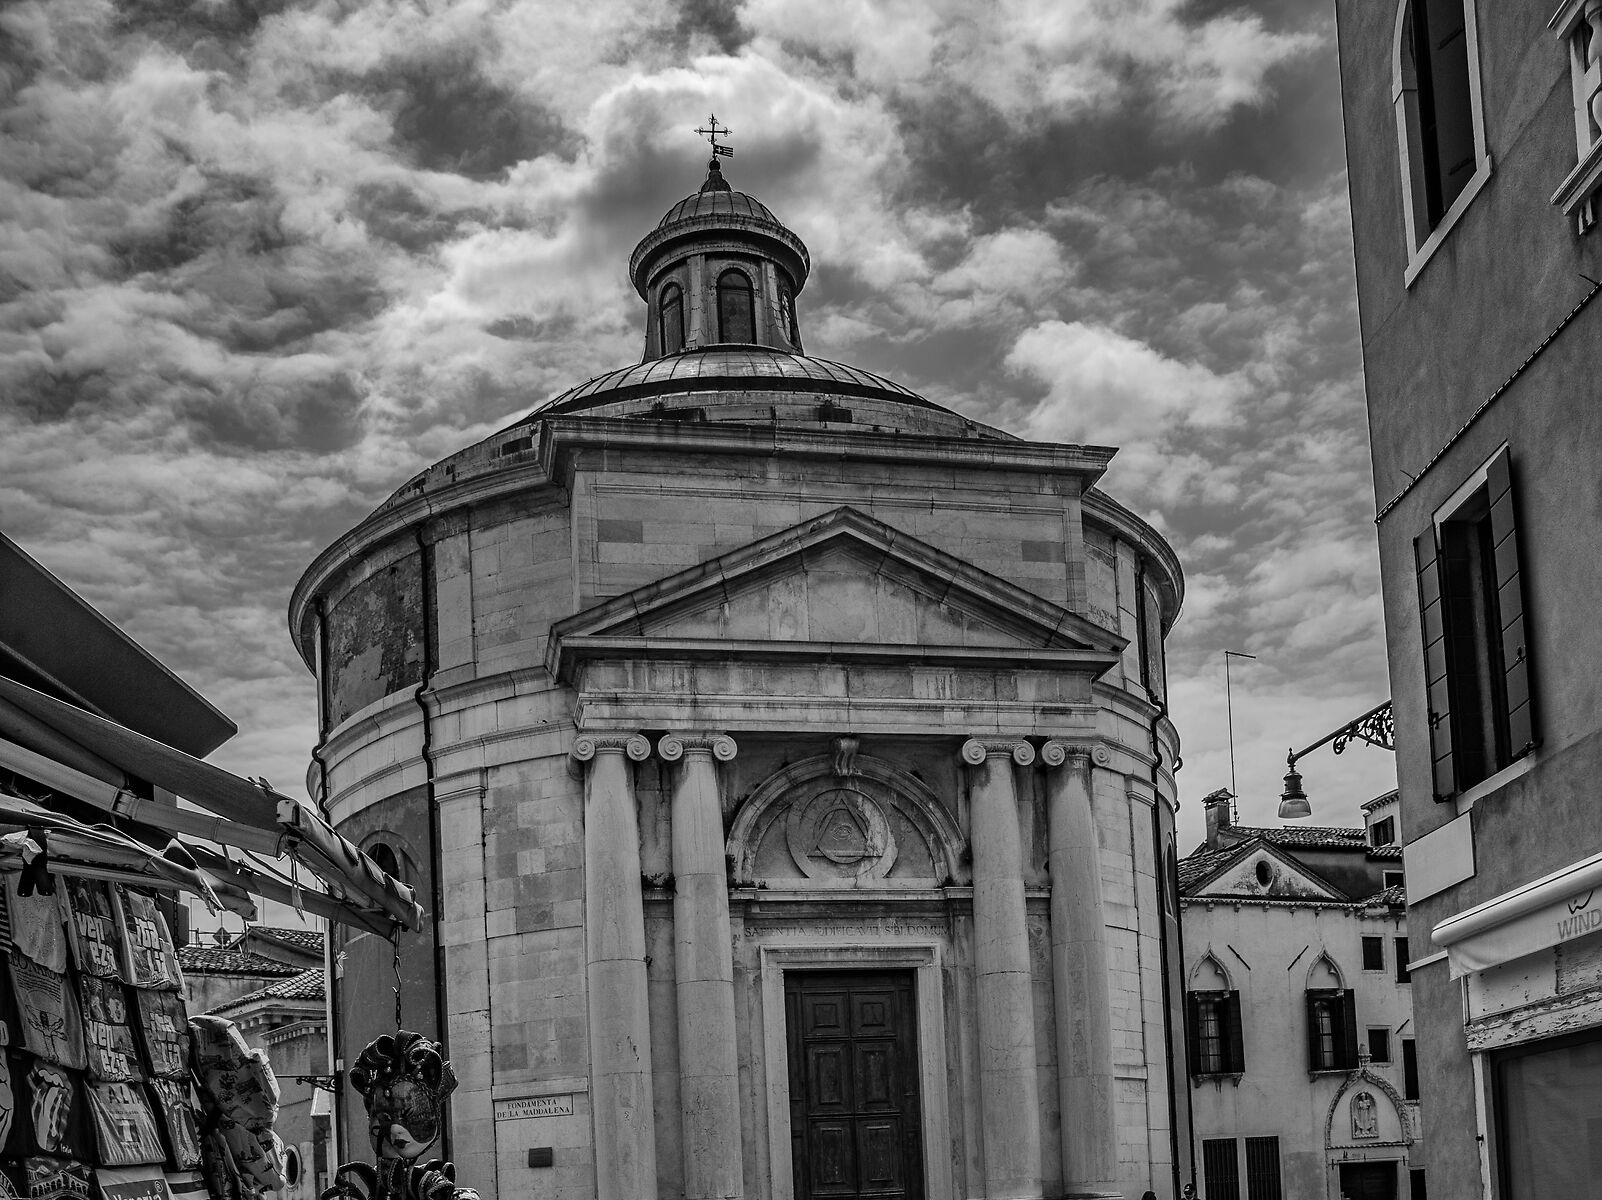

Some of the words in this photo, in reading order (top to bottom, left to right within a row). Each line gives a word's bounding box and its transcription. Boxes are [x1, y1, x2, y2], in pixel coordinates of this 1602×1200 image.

[507, 1099, 557, 1110] FONDAMENTA
[496, 1111, 507, 1119] DE
[509, 1109, 519, 1118] LA
[522, 1106, 570, 1117] MADDALENA
